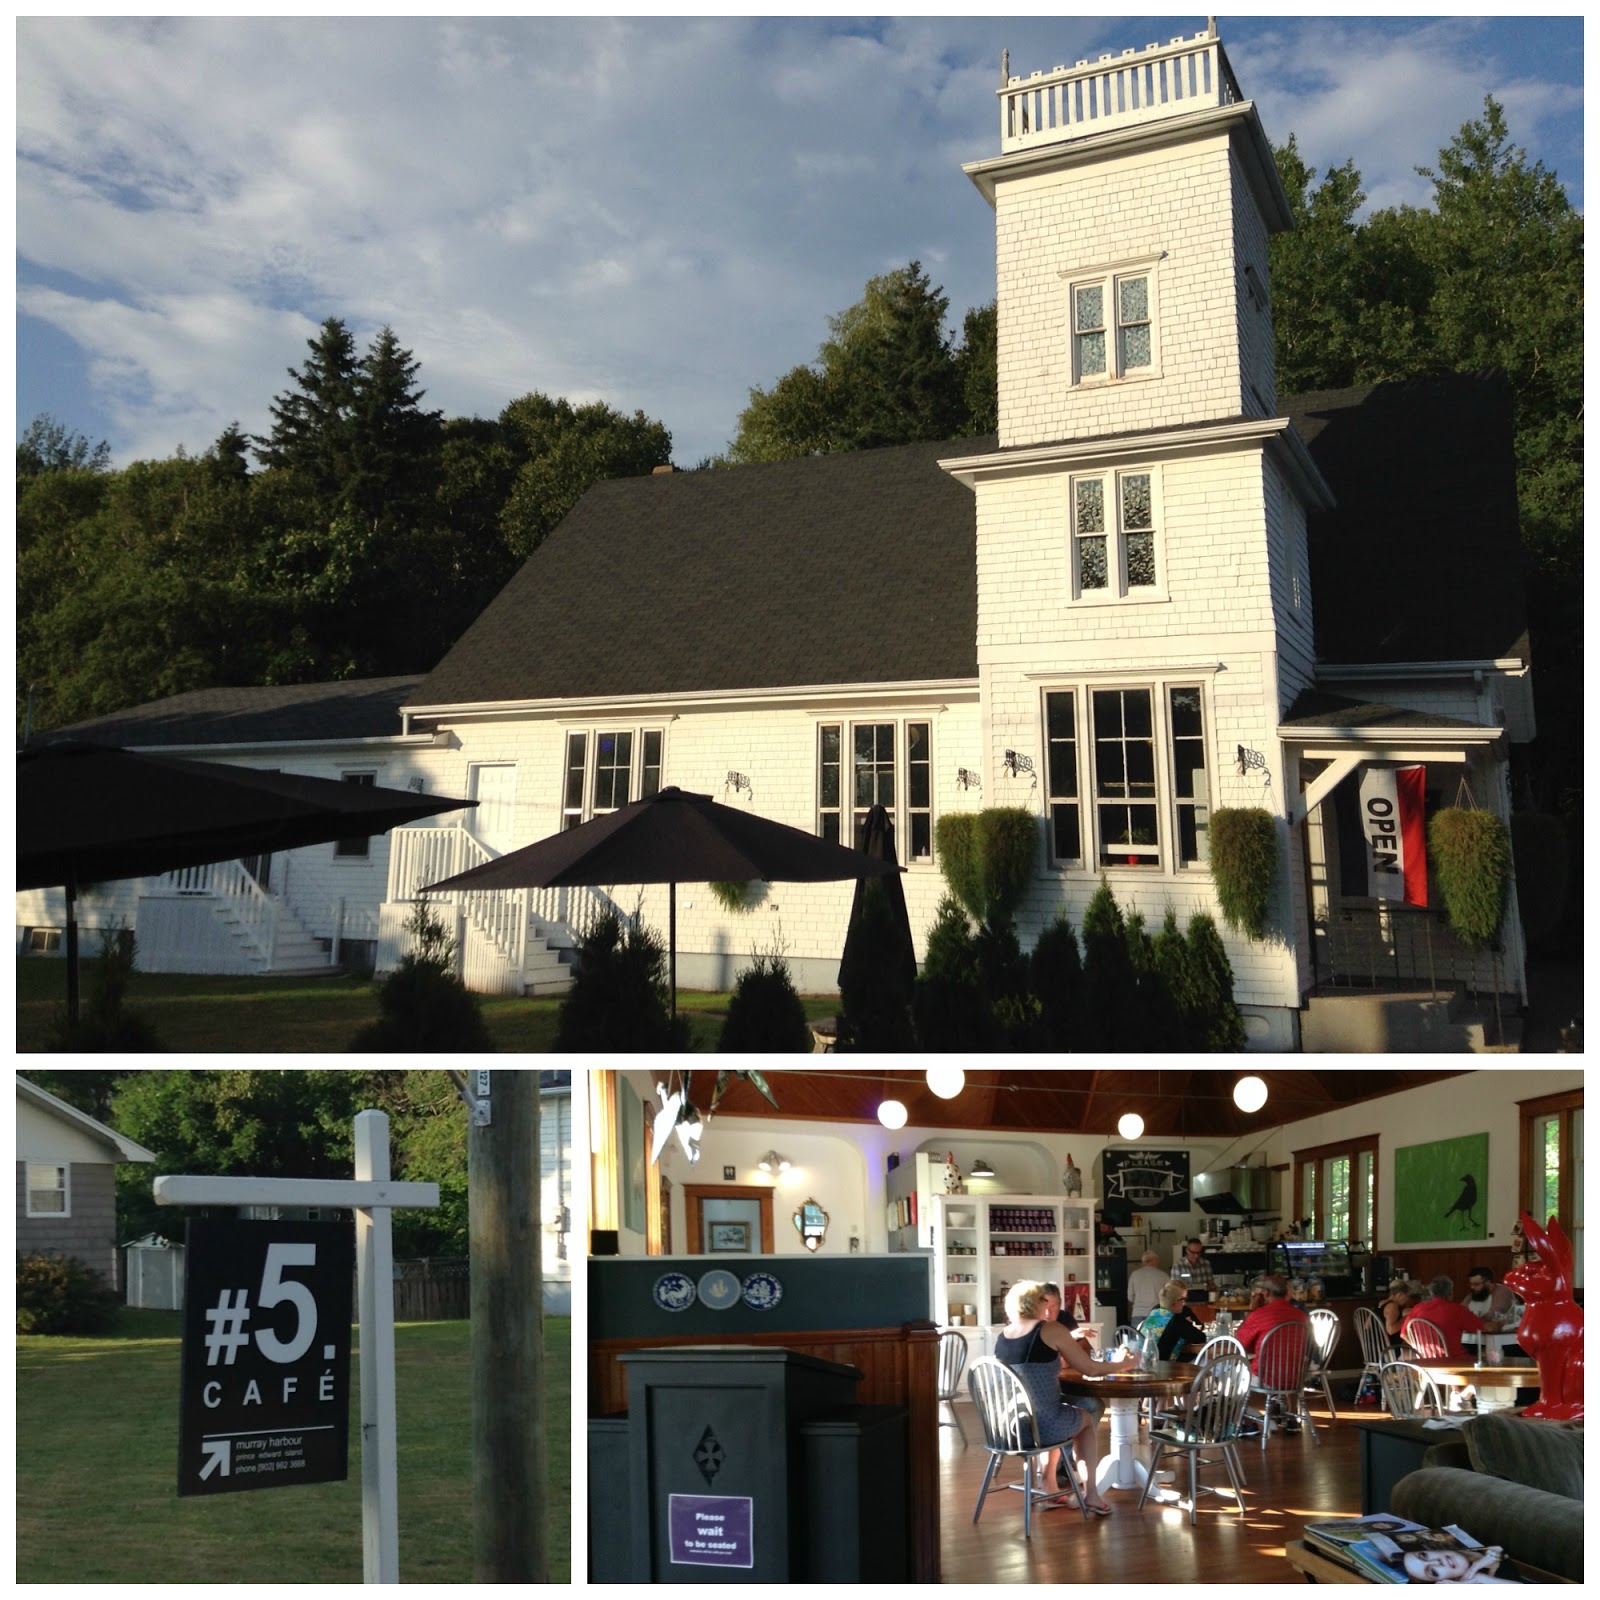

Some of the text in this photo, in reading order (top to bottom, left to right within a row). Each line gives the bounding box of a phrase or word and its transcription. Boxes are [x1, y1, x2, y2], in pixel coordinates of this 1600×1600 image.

[1367, 797, 1399, 874] OPEN
[203, 1369, 335, 1408] CAFÉ
[236, 1436, 303, 1450] murray harbour
[236, 1454, 255, 1462] prince
[258, 1451, 281, 1459] edward
[235, 1465, 257, 1474] phone
[695, 1513, 725, 1521] Please
[697, 1526, 723, 1536] wait
[695, 1540, 706, 1548] be
